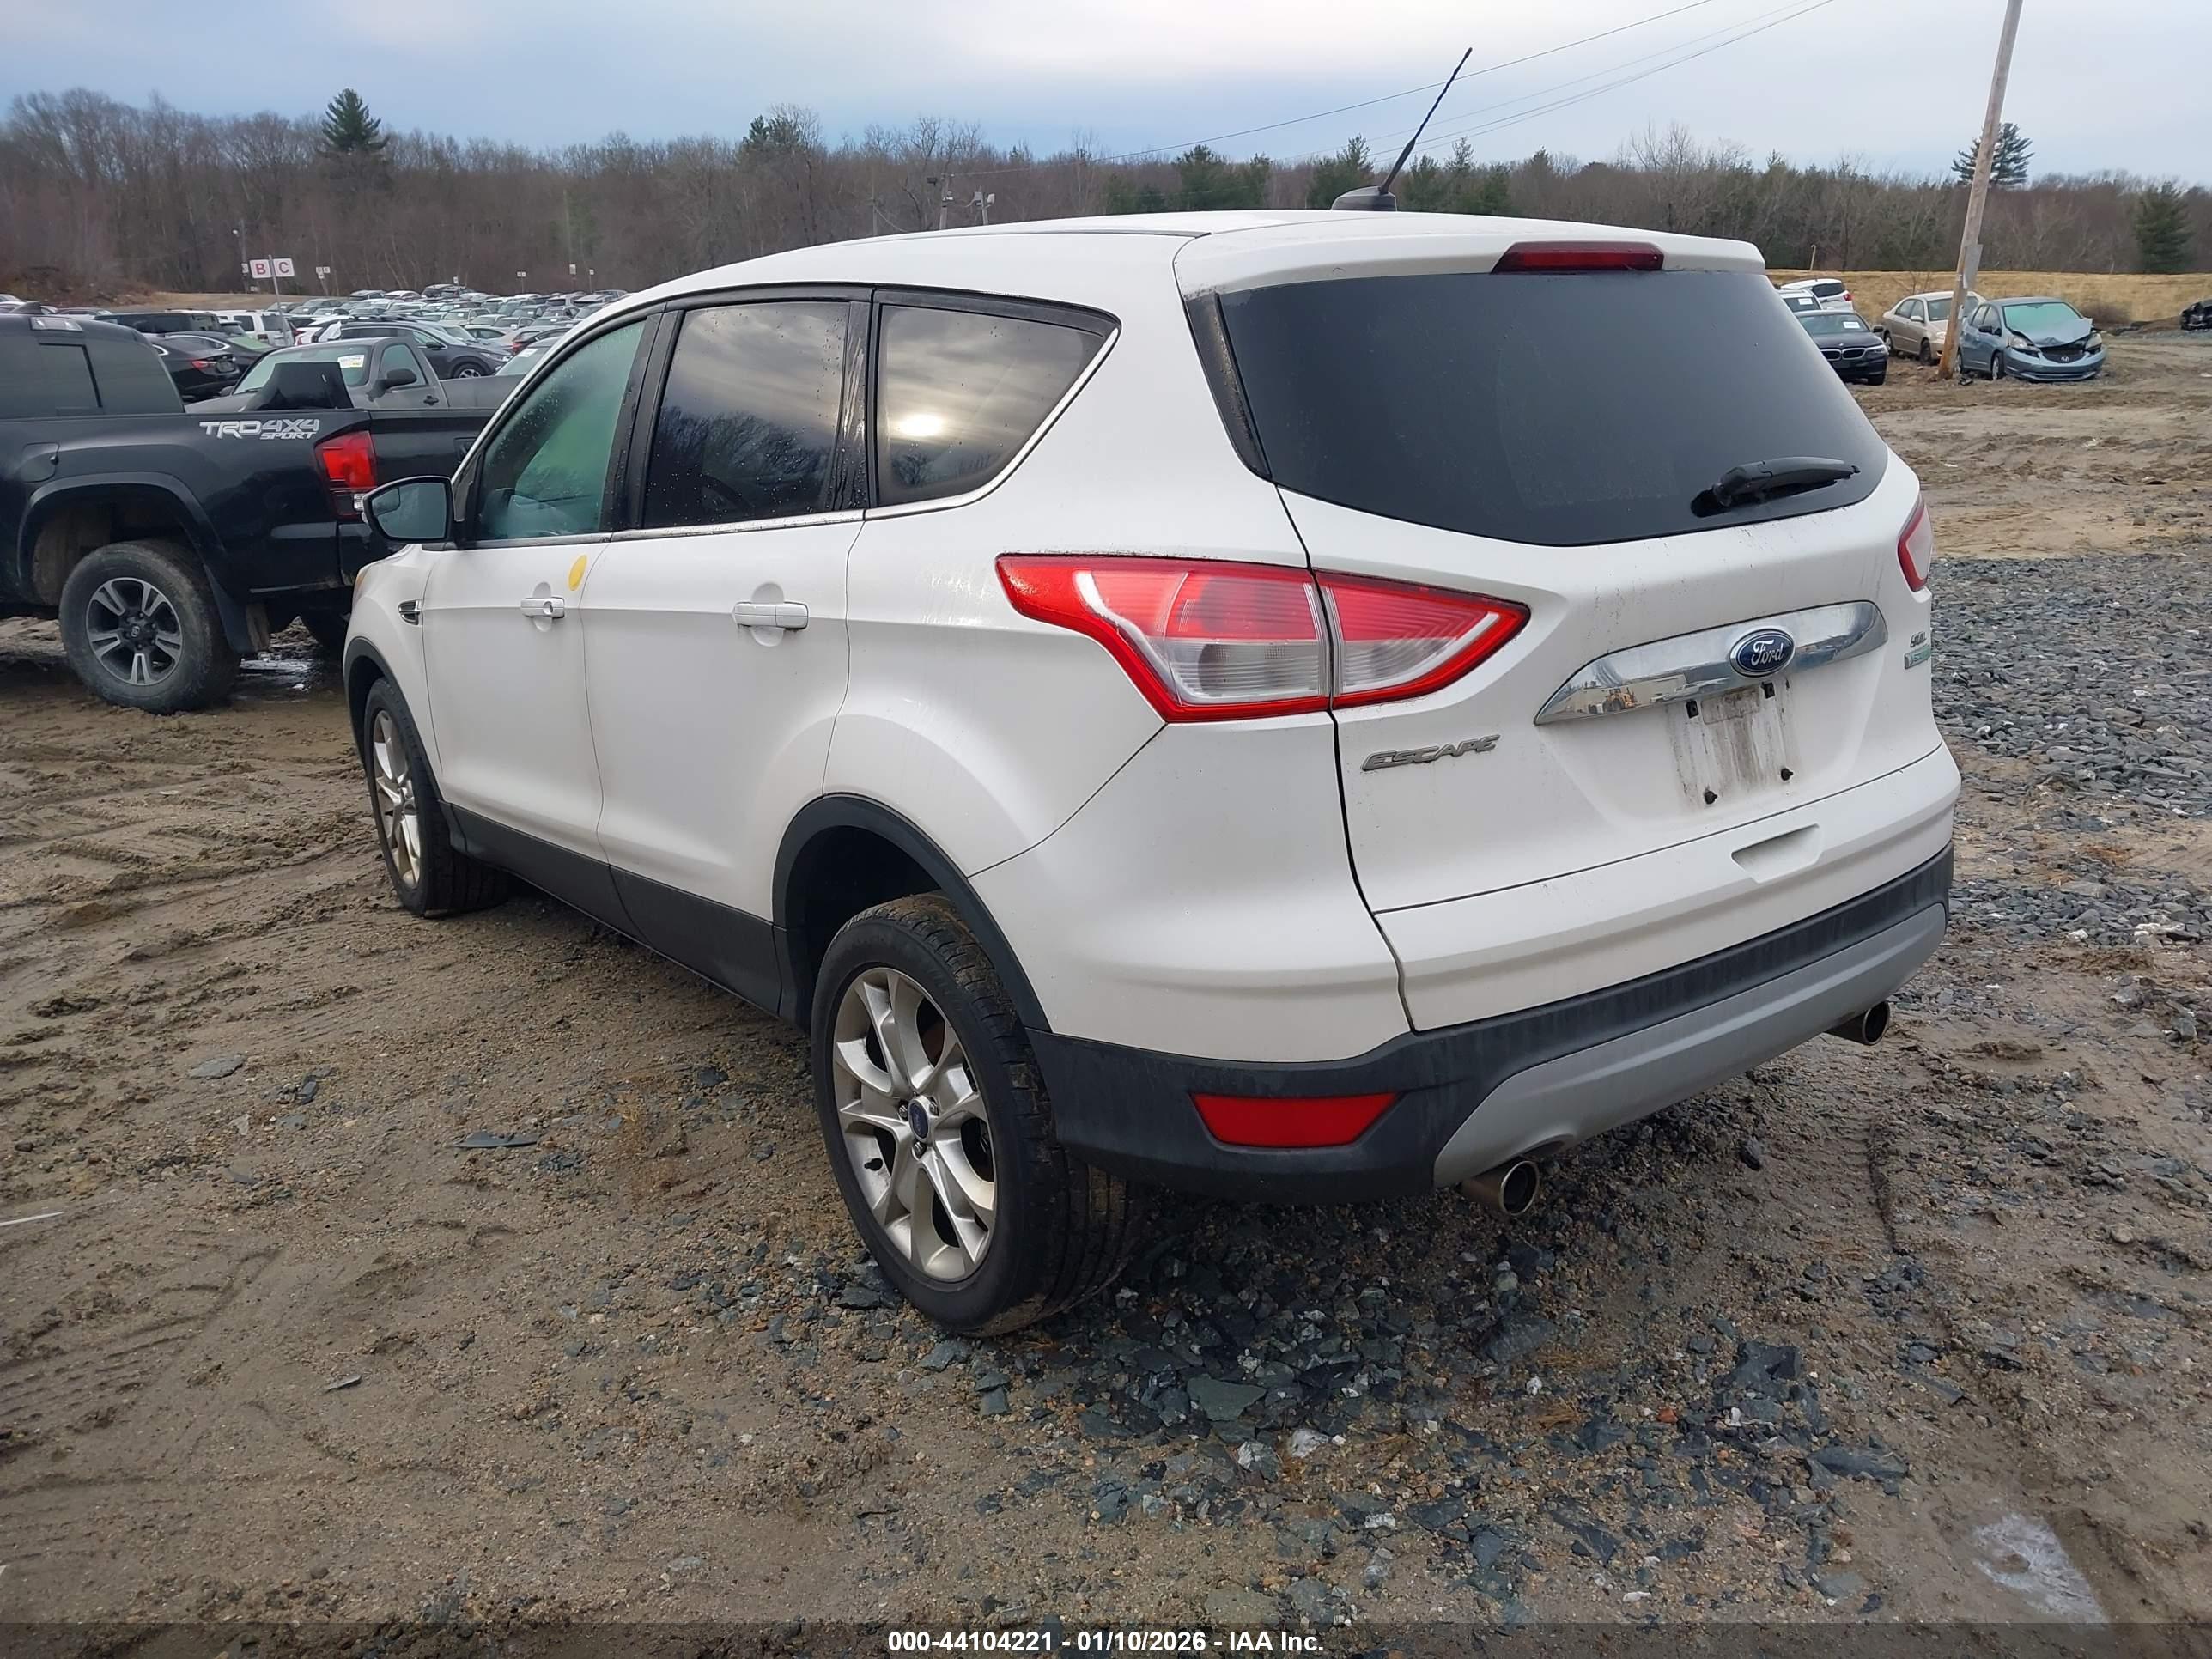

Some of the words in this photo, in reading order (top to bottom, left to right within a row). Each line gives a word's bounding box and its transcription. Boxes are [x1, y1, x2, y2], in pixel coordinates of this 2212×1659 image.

[255, 263, 266, 275] B
[278, 261, 289, 274] C
[199, 420, 261, 439] TRD
[1751, 639, 1784, 666] Ford
[1361, 734, 1501, 772] ESCAPE
